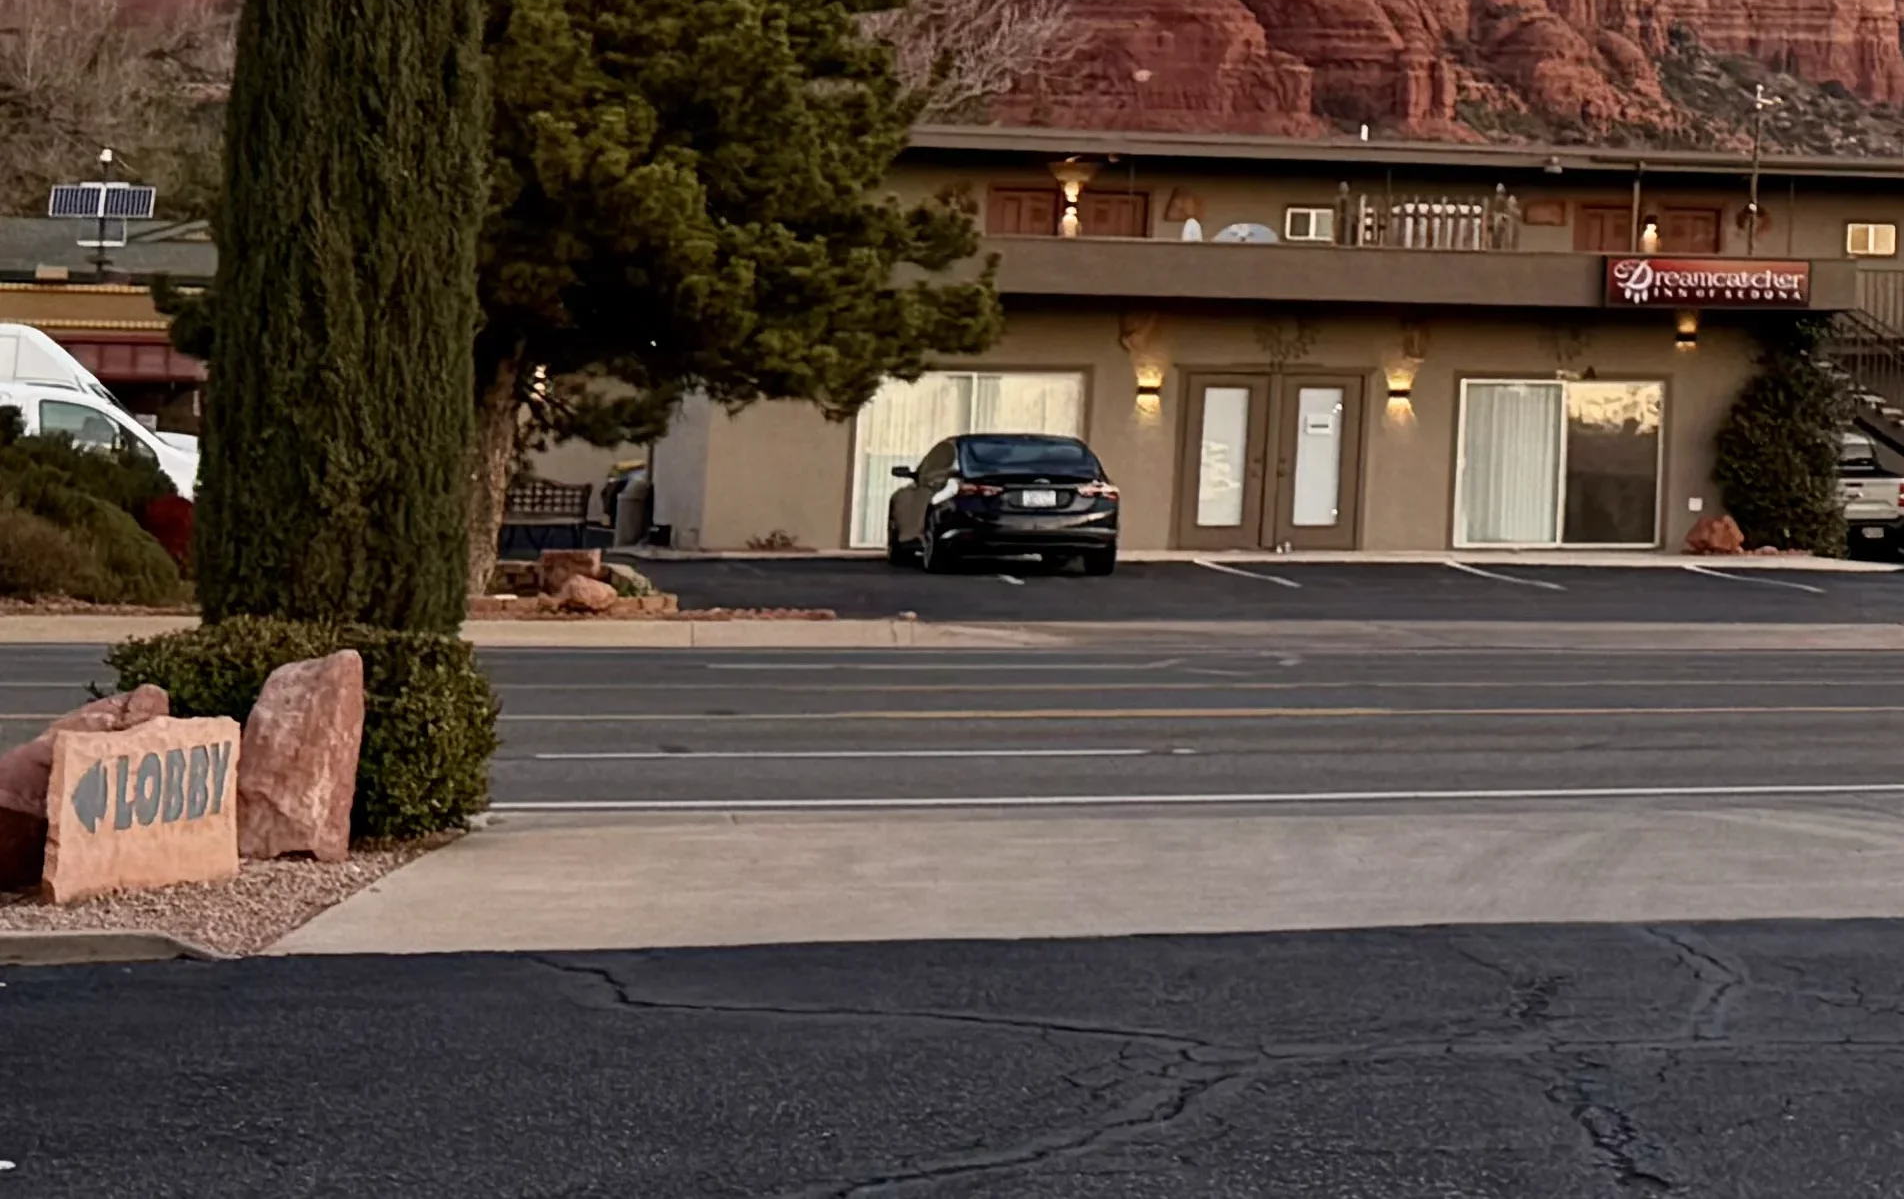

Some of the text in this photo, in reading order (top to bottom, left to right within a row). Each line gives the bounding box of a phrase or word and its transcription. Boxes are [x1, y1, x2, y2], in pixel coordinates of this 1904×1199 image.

[1613, 259, 1804, 291] Dreamcatcher
[1653, 287, 1689, 298] INN
[114, 740, 232, 831] LOBBY
